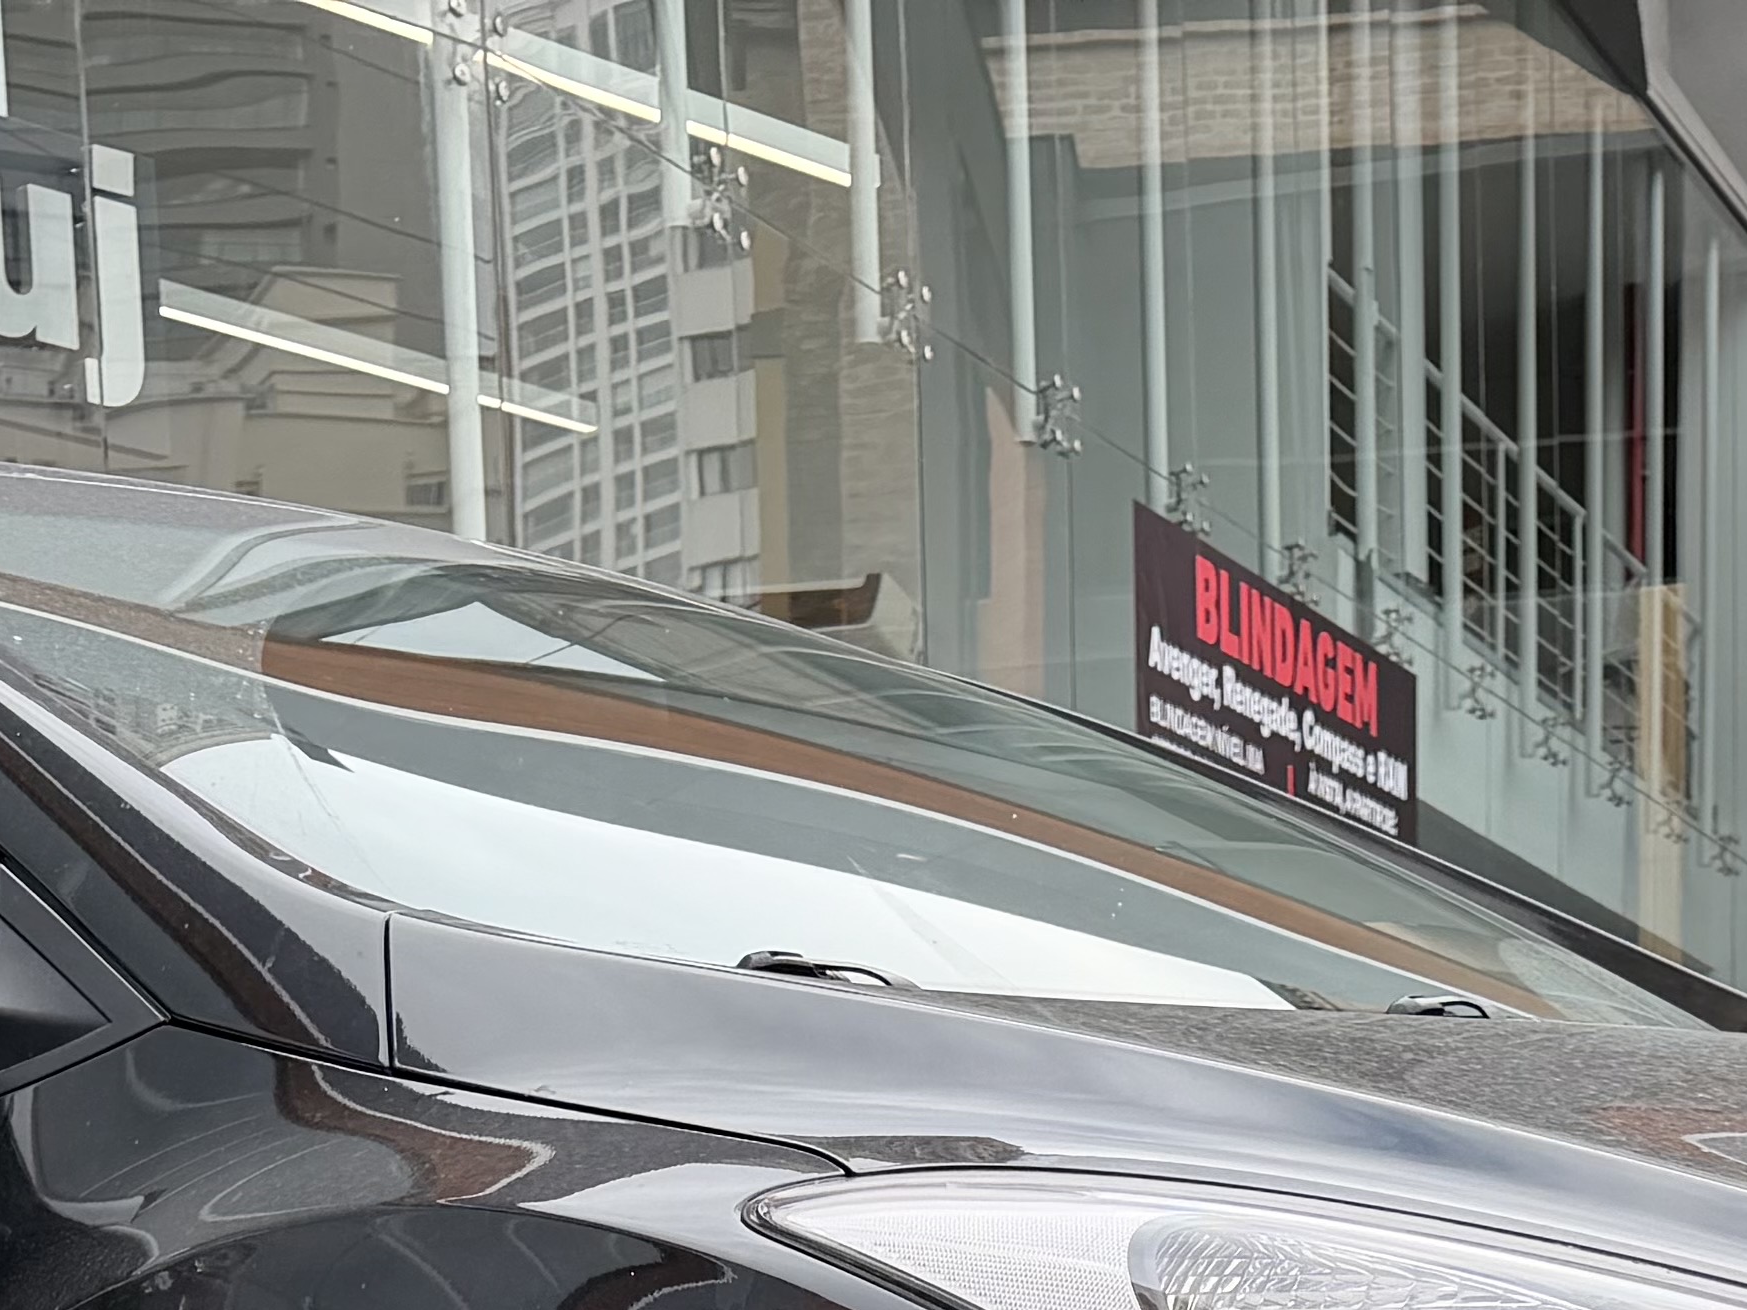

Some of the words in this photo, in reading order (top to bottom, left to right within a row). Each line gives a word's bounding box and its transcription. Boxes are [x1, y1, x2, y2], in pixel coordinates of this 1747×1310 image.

[1148, 626, 1222, 710] Avenger,
[1222, 665, 1302, 752] Renegade,
[1302, 709, 1365, 778] Compass
[1366, 754, 1376, 784] e
[1196, 554, 1378, 737] BLINDAGEM
